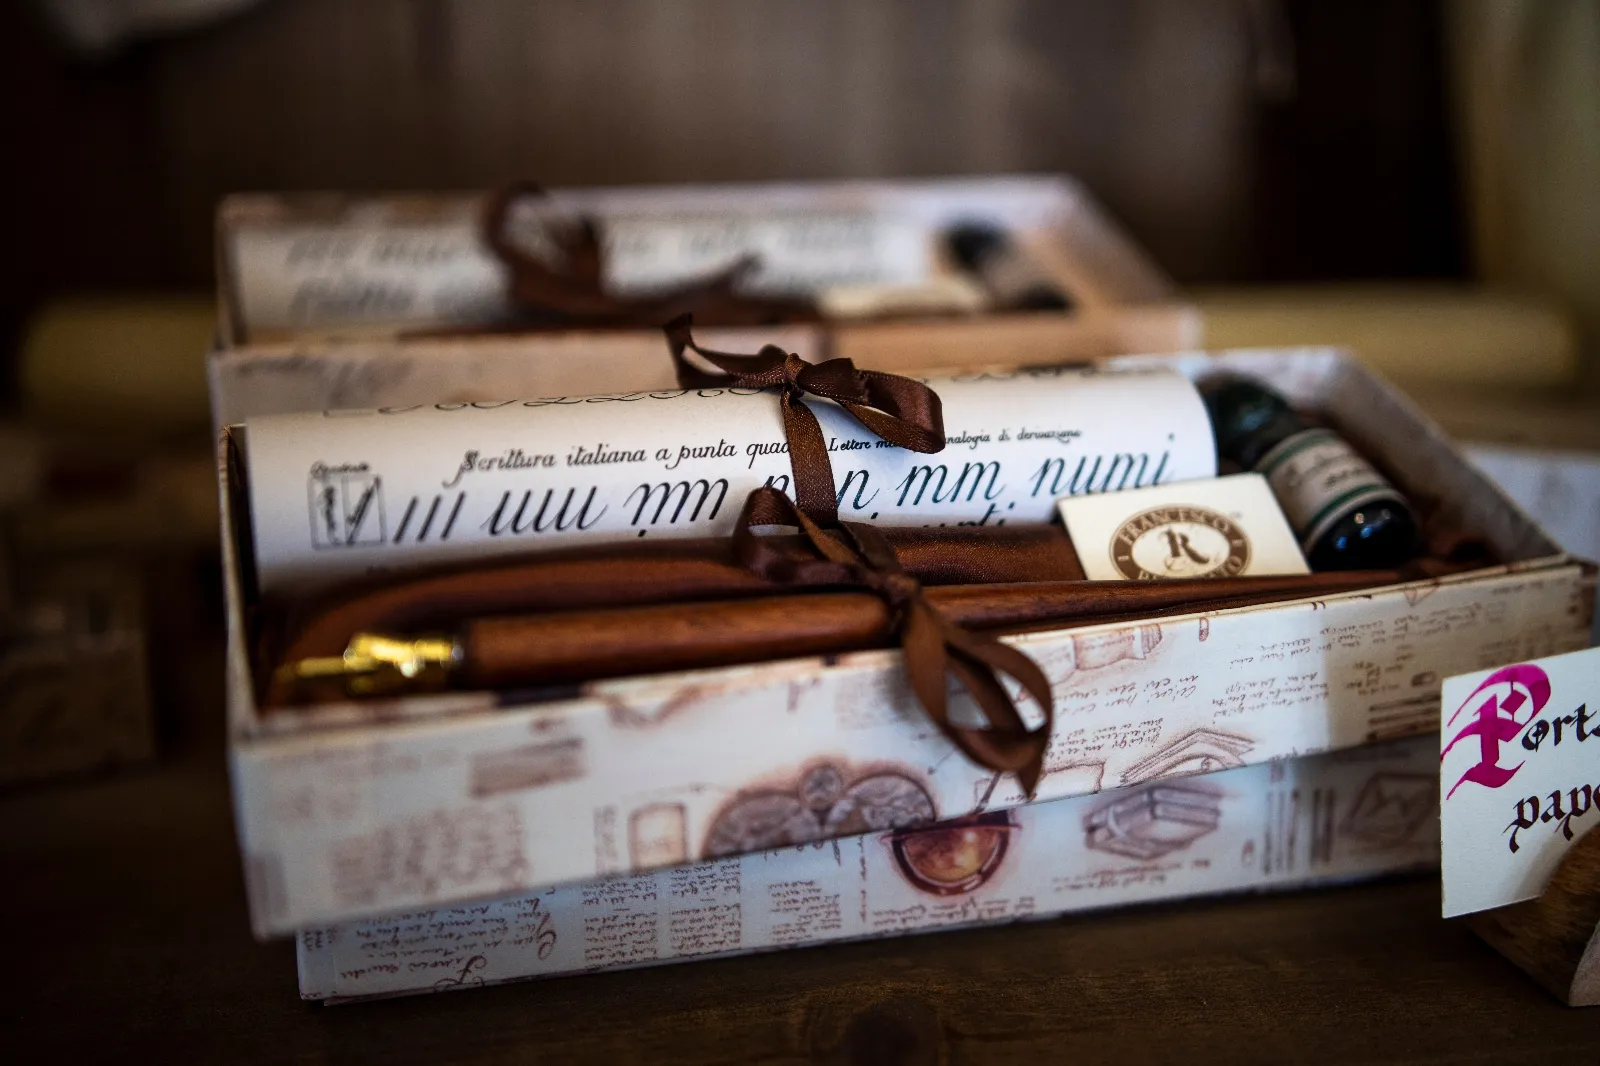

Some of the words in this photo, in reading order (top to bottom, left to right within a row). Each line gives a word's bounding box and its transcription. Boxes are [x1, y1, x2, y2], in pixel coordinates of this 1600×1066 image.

[566, 442, 647, 467] italiana
[655, 448, 673, 465] a
[666, 438, 737, 470] punta
[828, 437, 871, 452] Lettere
[944, 429, 990, 450] nalogia
